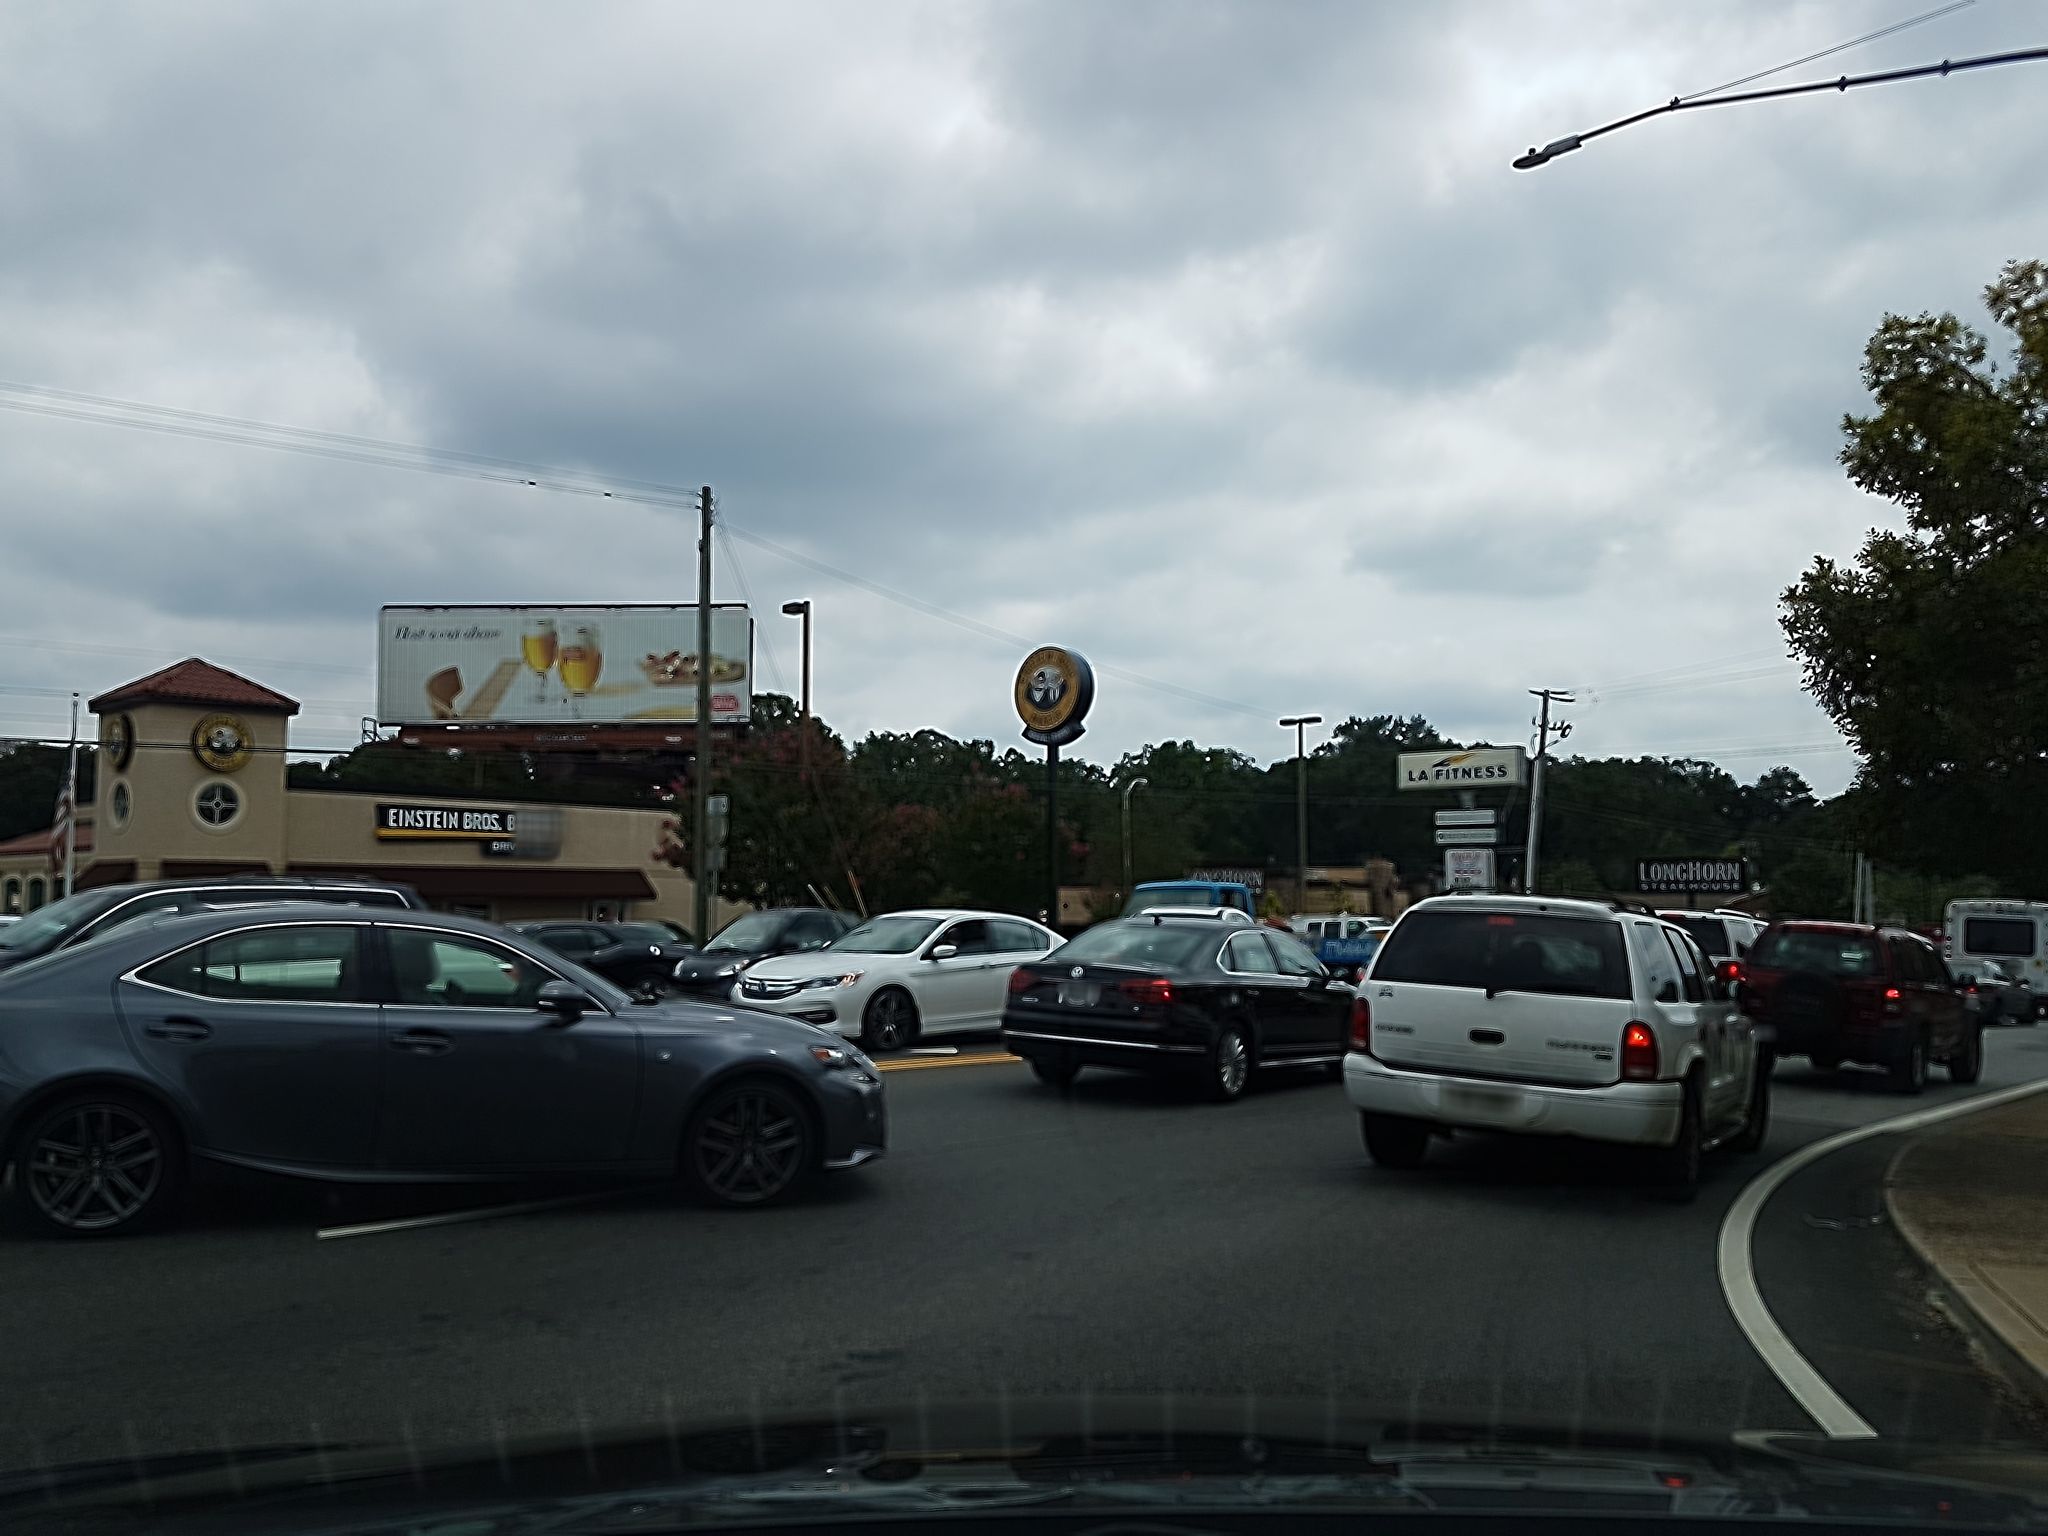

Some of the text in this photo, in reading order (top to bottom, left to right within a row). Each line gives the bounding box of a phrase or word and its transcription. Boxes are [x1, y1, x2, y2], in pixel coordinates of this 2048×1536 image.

[1408, 764, 1508, 782] LA FITNESS
[388, 808, 459, 830] EINSTEIN
[463, 811, 502, 831] BROS.
[1639, 861, 1740, 881] LONGHORN
[1640, 882, 1741, 891] STEAKHOUSE
